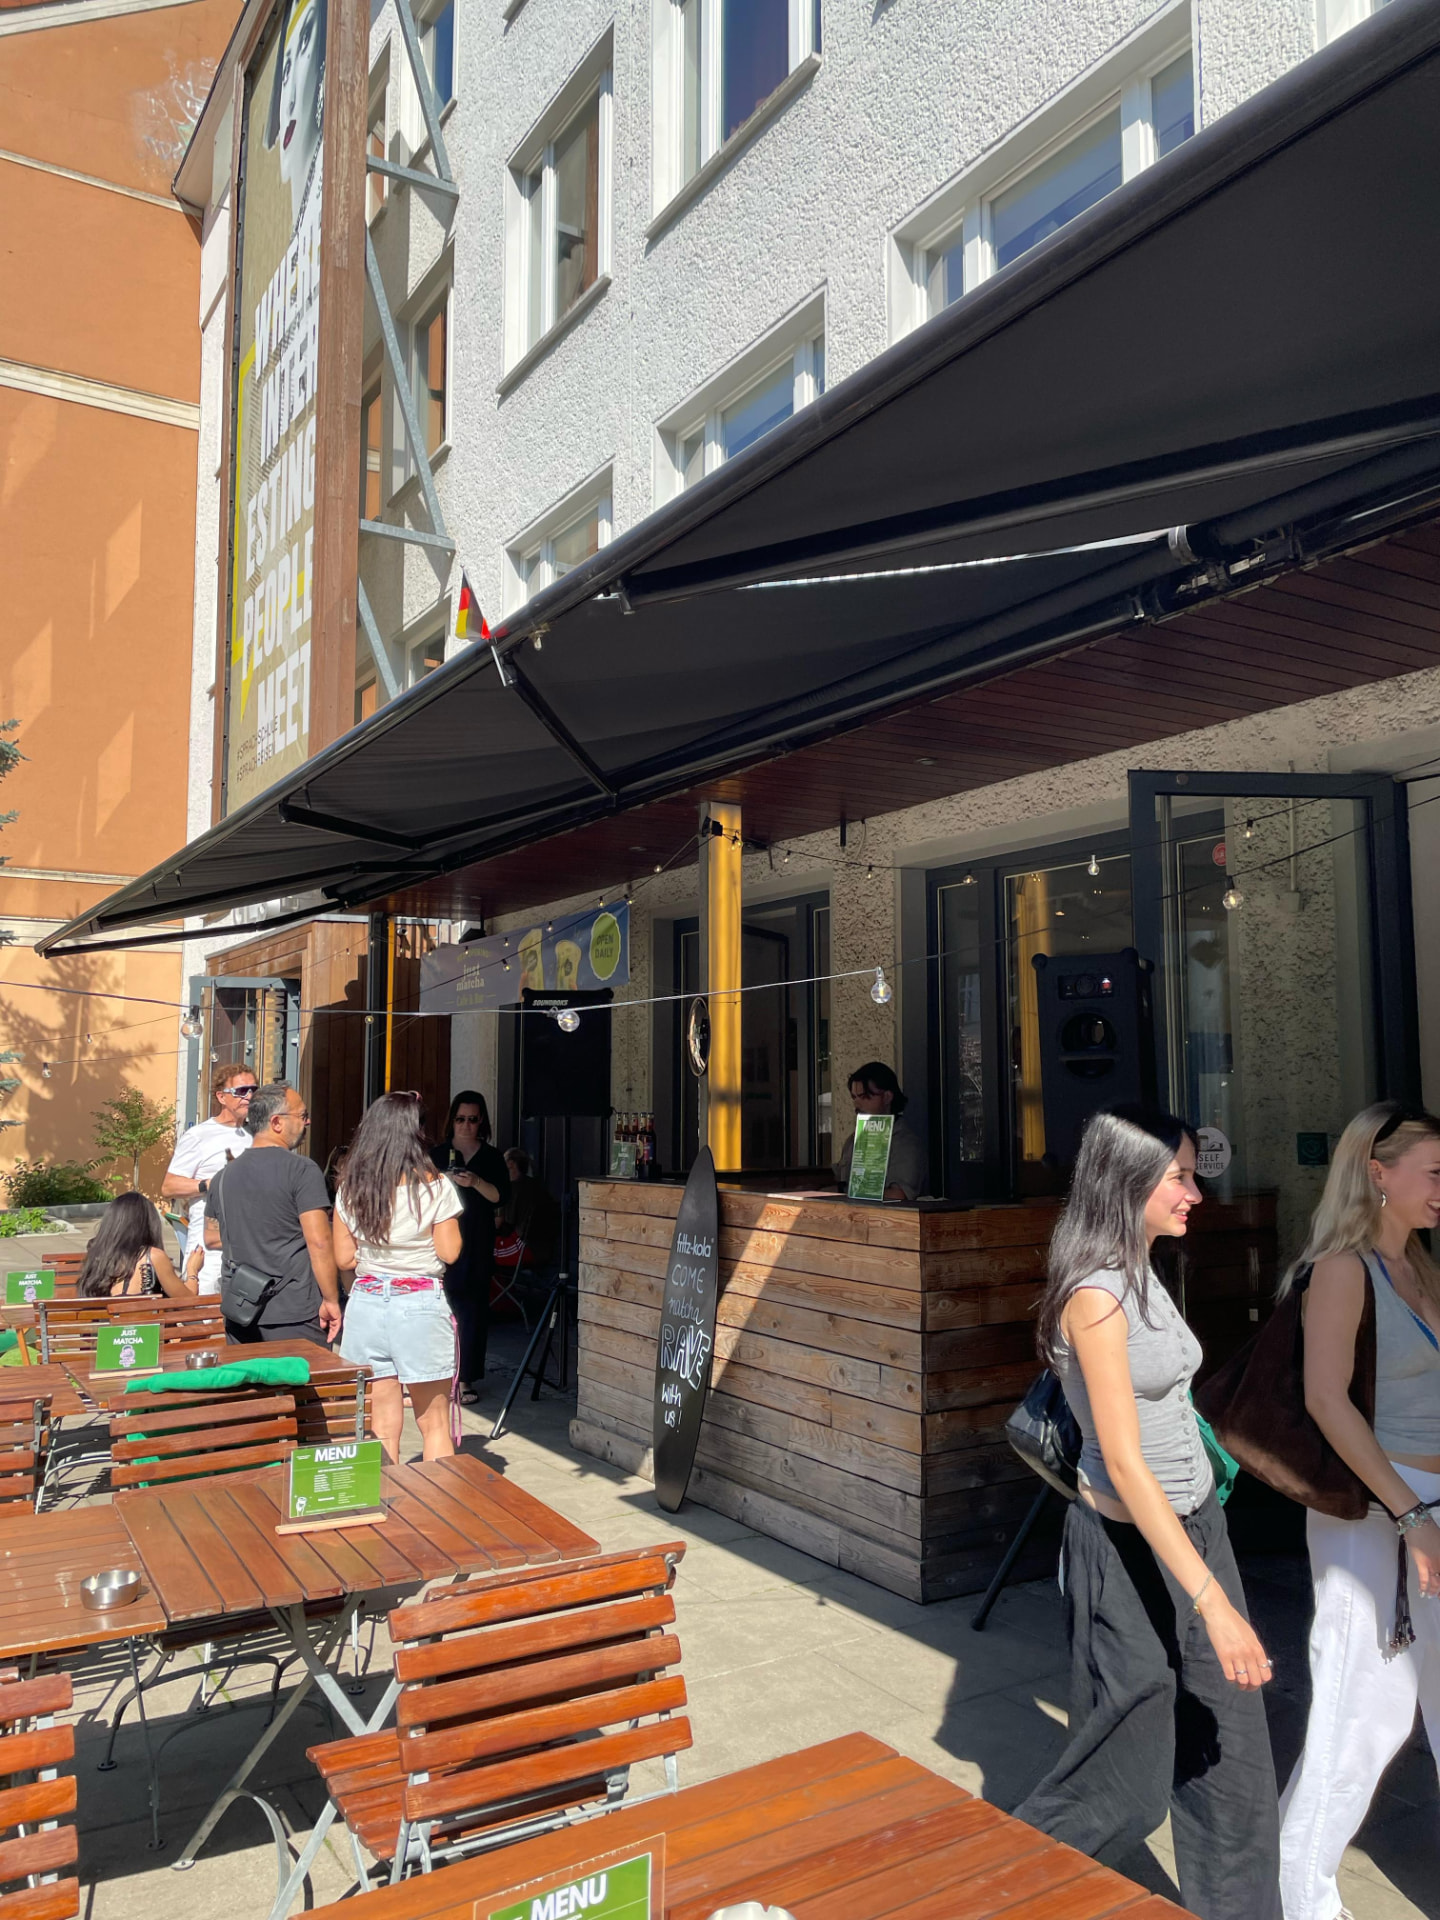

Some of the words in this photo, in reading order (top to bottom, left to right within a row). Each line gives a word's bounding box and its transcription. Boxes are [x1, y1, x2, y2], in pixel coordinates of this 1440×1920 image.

[246, 415, 316, 581] ESTING
[243, 526, 313, 681] PEOPLE
[257, 639, 311, 767] MEET
[596, 933, 614, 945] OPEN
[595, 948, 614, 959] DAILY
[456, 976, 485, 991] matcha
[863, 1120, 886, 1132] MENU
[1199, 1154, 1220, 1162] SELF
[671, 1264, 706, 1294] COME
[113, 1337, 144, 1345] MATCHA
[661, 1324, 711, 1391] RAVE
[314, 1445, 357, 1462] MENU
[531, 1873, 607, 1920] MENU
